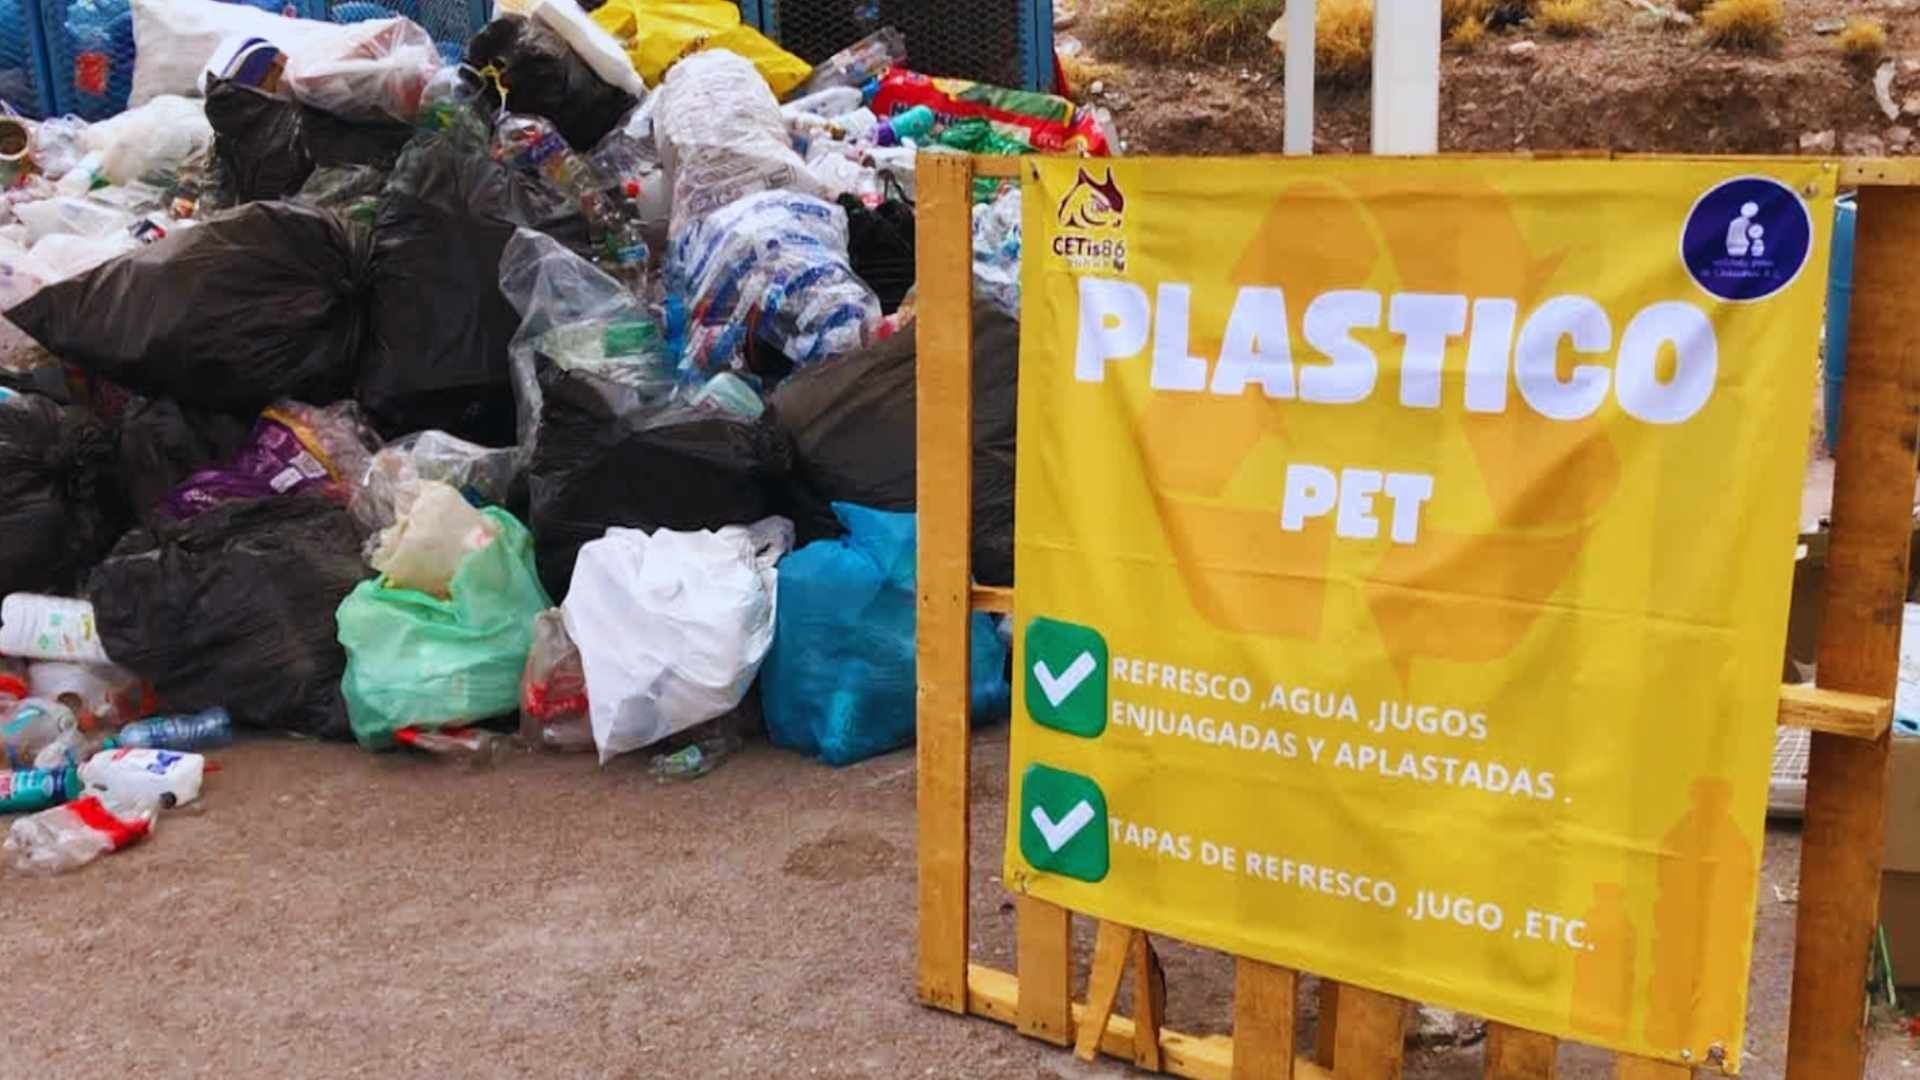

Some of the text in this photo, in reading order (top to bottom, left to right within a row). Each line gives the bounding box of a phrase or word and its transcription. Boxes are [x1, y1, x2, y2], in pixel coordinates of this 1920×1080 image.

[1053, 236, 1125, 258] CETis86
[1074, 276, 1718, 425] PLASTICO
[1281, 464, 1434, 545] PET
[1112, 656, 1252, 704] REFRESCO
[1111, 700, 1298, 758] ENJUAGADAS
[1305, 736, 1326, 764] Y
[1334, 741, 1556, 800] APLASTADAS
[1109, 816, 1192, 862] TAPAS
[1200, 840, 1237, 872] DE
[1245, 851, 1397, 908] REFRESCO
